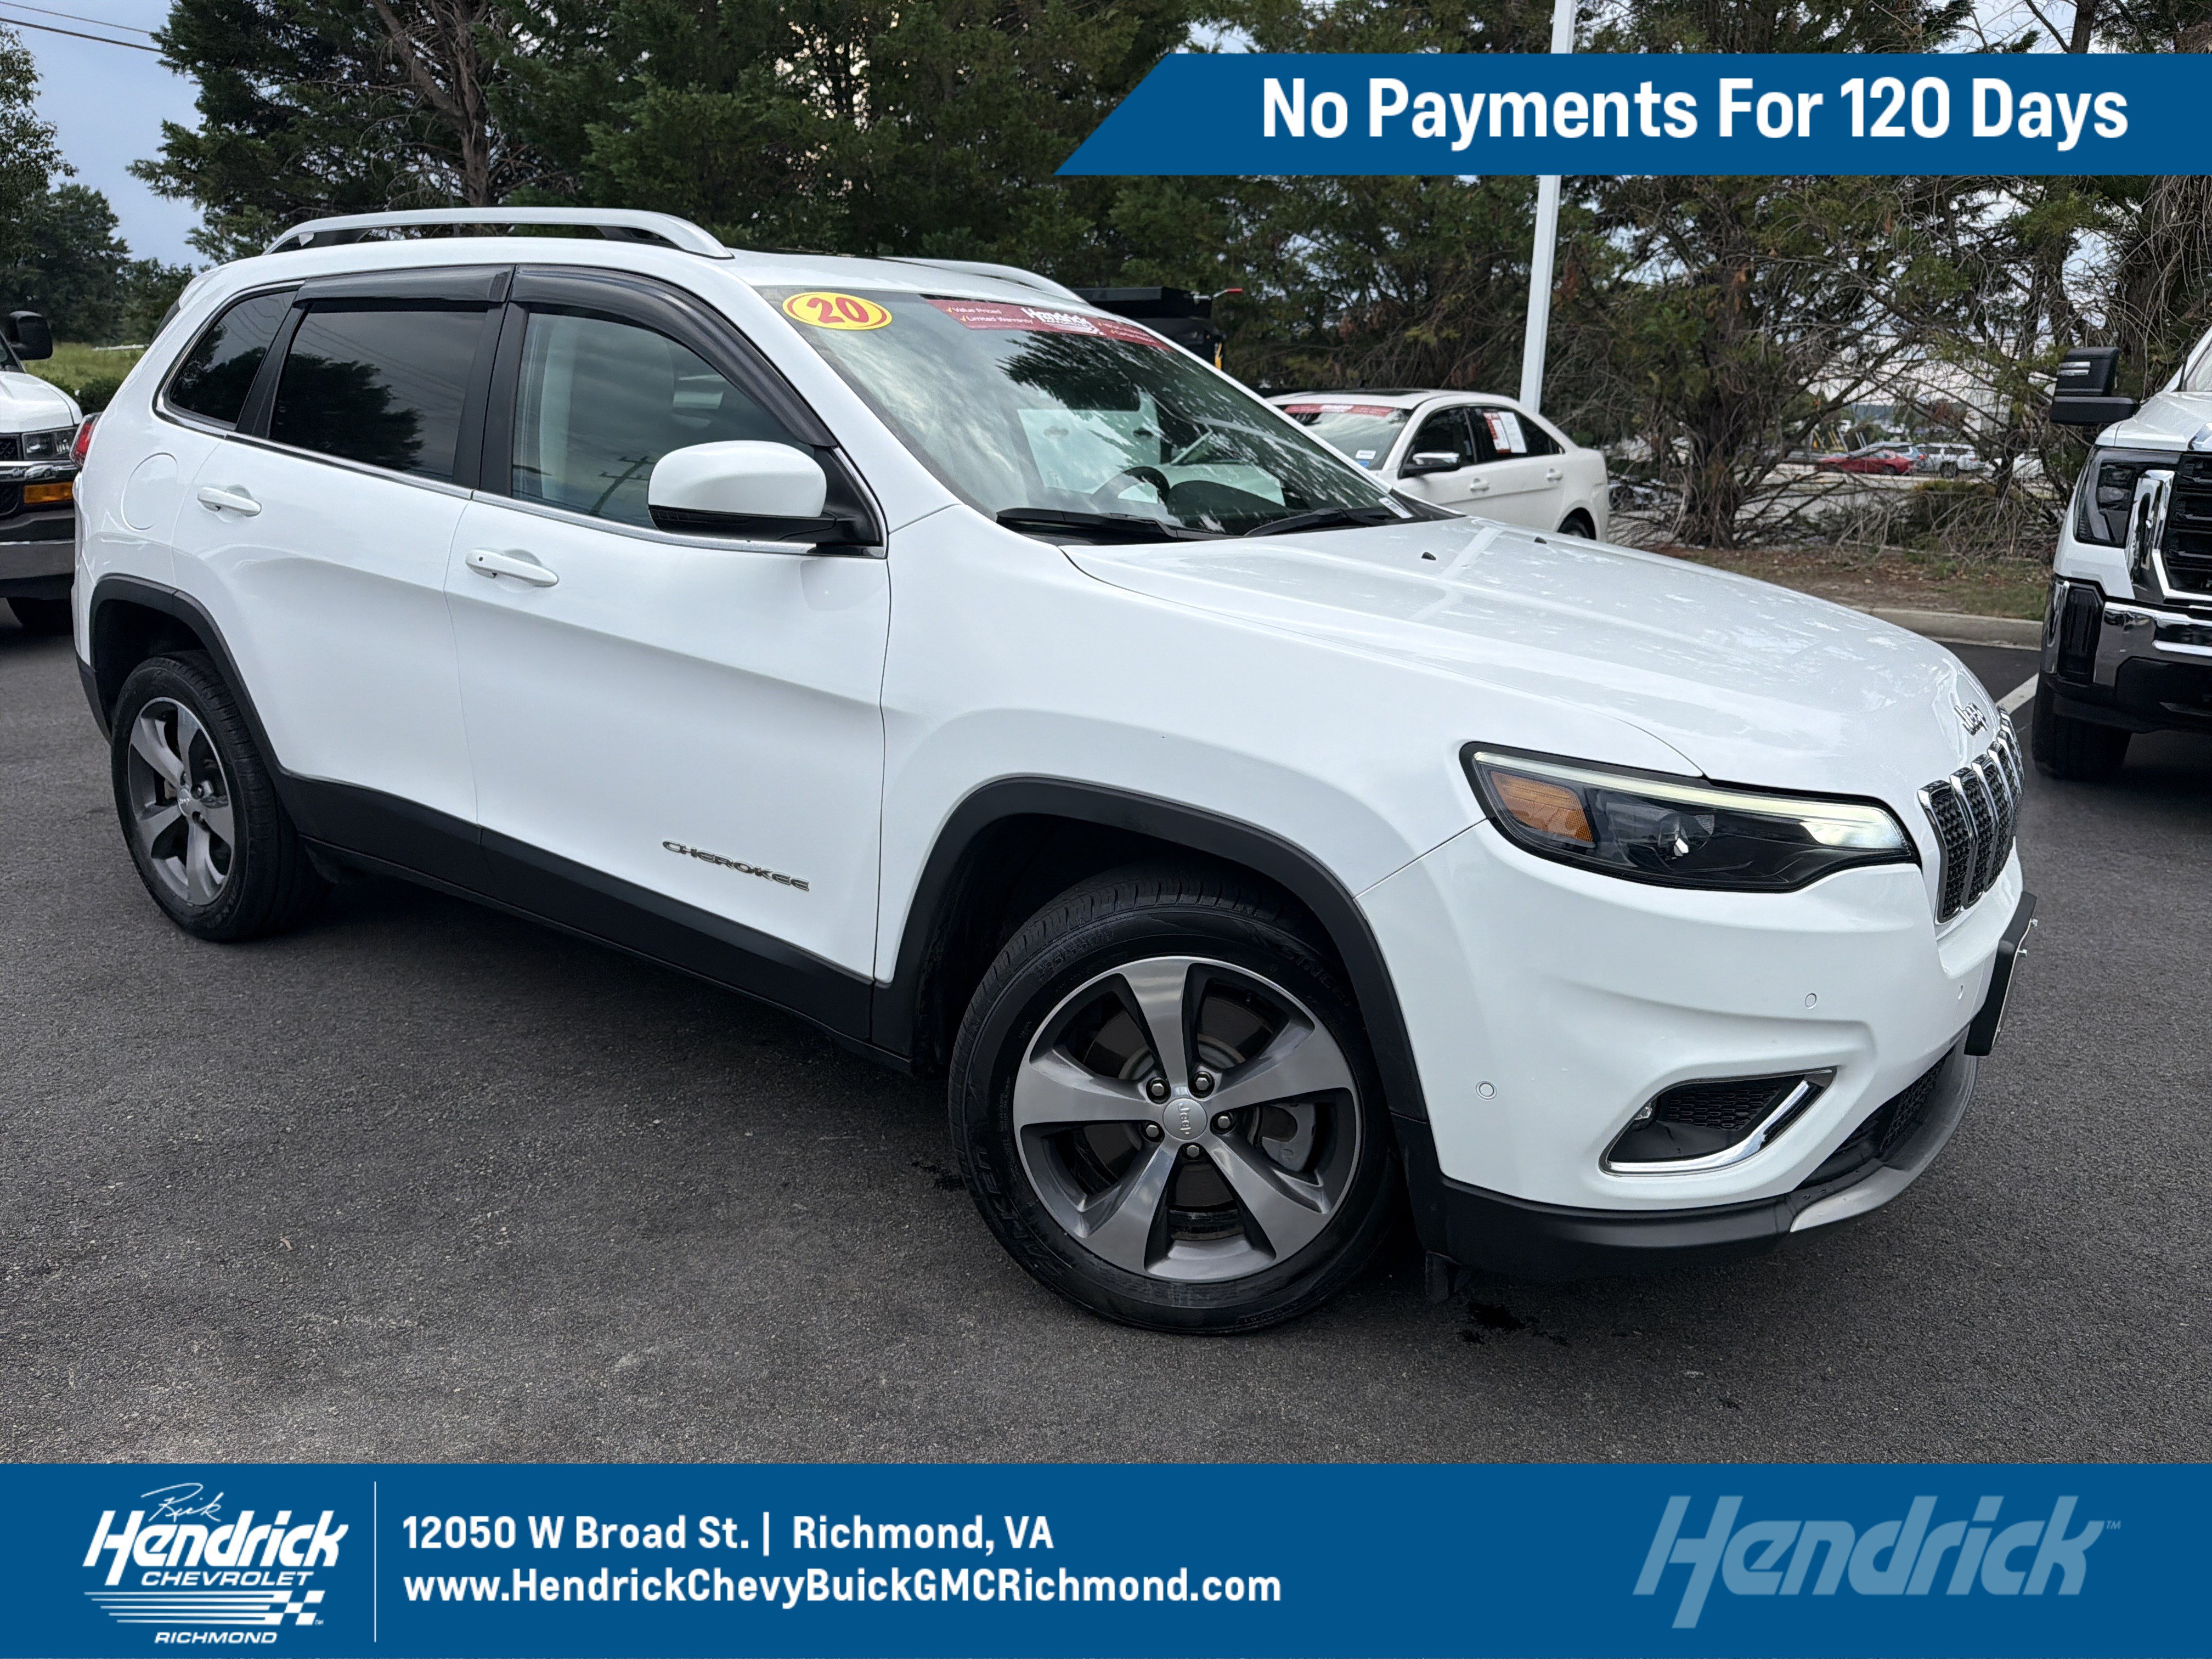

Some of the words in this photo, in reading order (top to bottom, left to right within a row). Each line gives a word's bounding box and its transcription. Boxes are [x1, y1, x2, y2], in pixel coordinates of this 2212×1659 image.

[806, 297, 870, 324] 20
[1954, 702, 1989, 736] Jeep
[662, 839, 810, 892] CHEROKEE
[1177, 1103, 1191, 1135] Jeep
